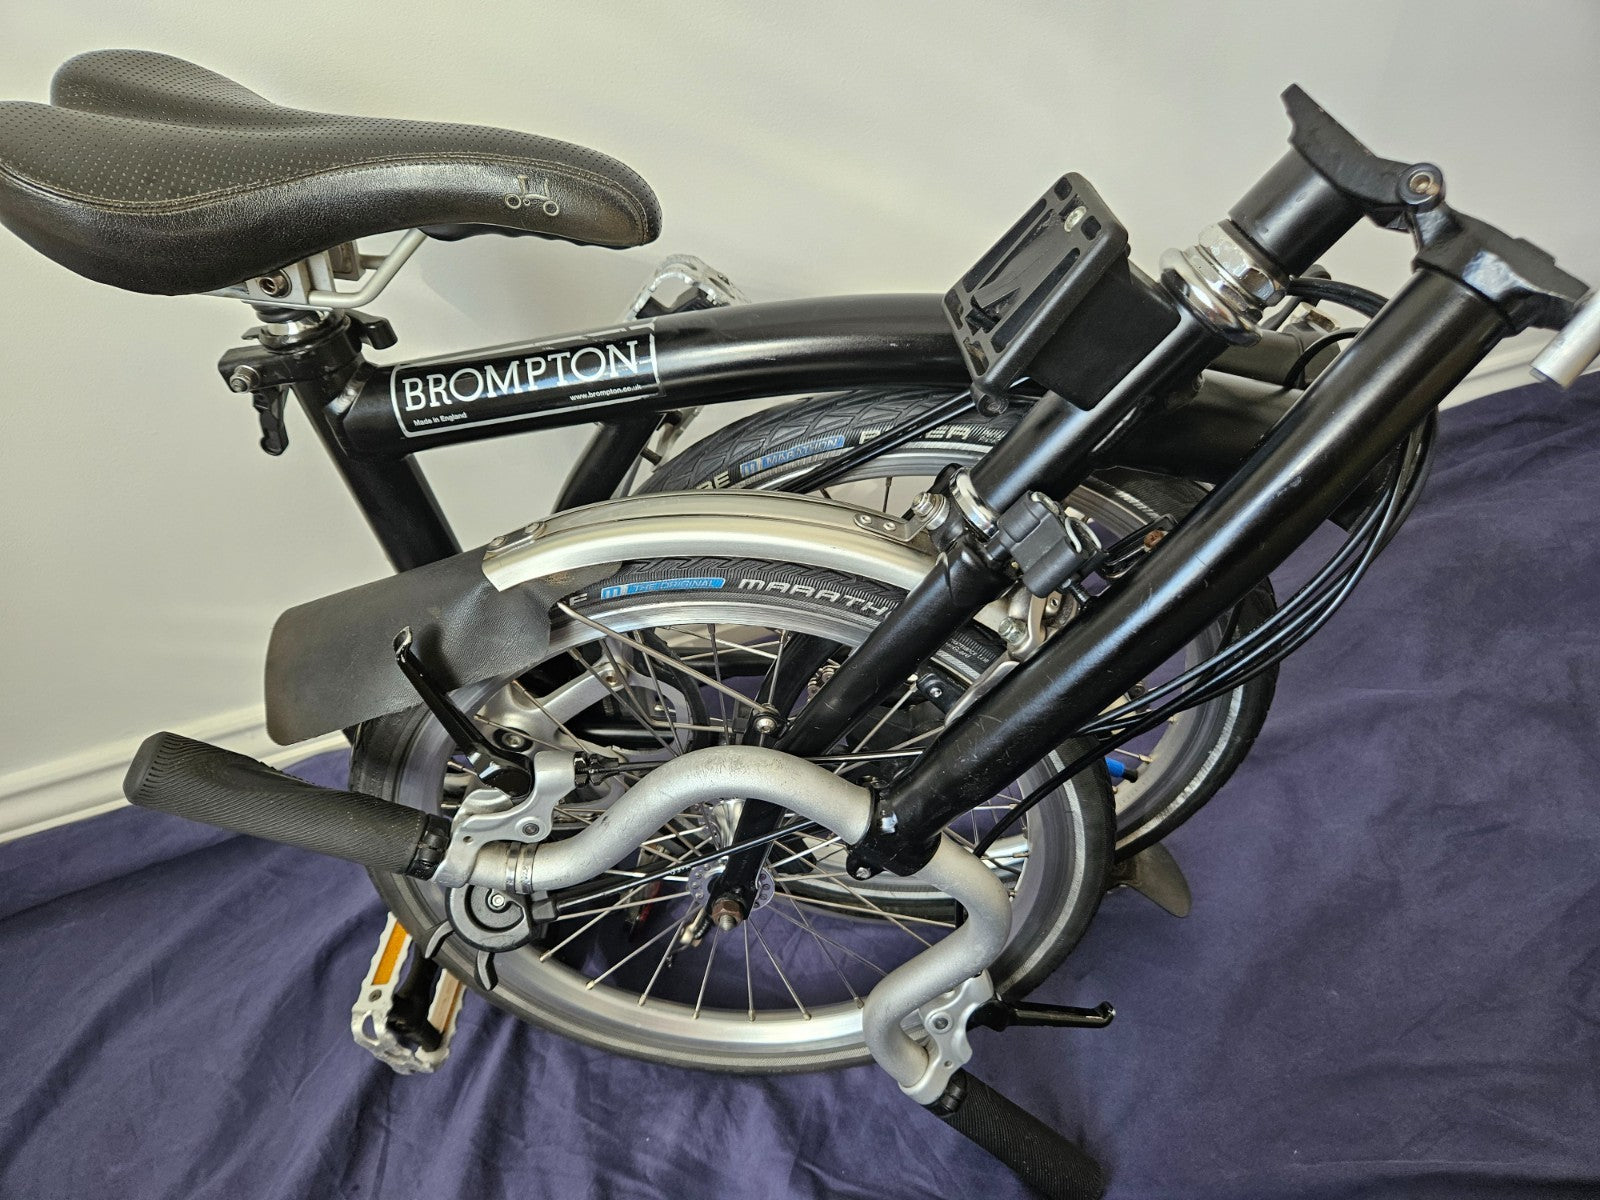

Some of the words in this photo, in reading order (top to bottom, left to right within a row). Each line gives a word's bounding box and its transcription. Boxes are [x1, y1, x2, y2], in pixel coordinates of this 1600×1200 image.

[402, 340, 638, 412] BROMPTON
[569, 383, 642, 401] www.brompton.co.uk
[413, 418, 433, 427] Made
[440, 411, 468, 422] England
[738, 578, 894, 619] MARATH
